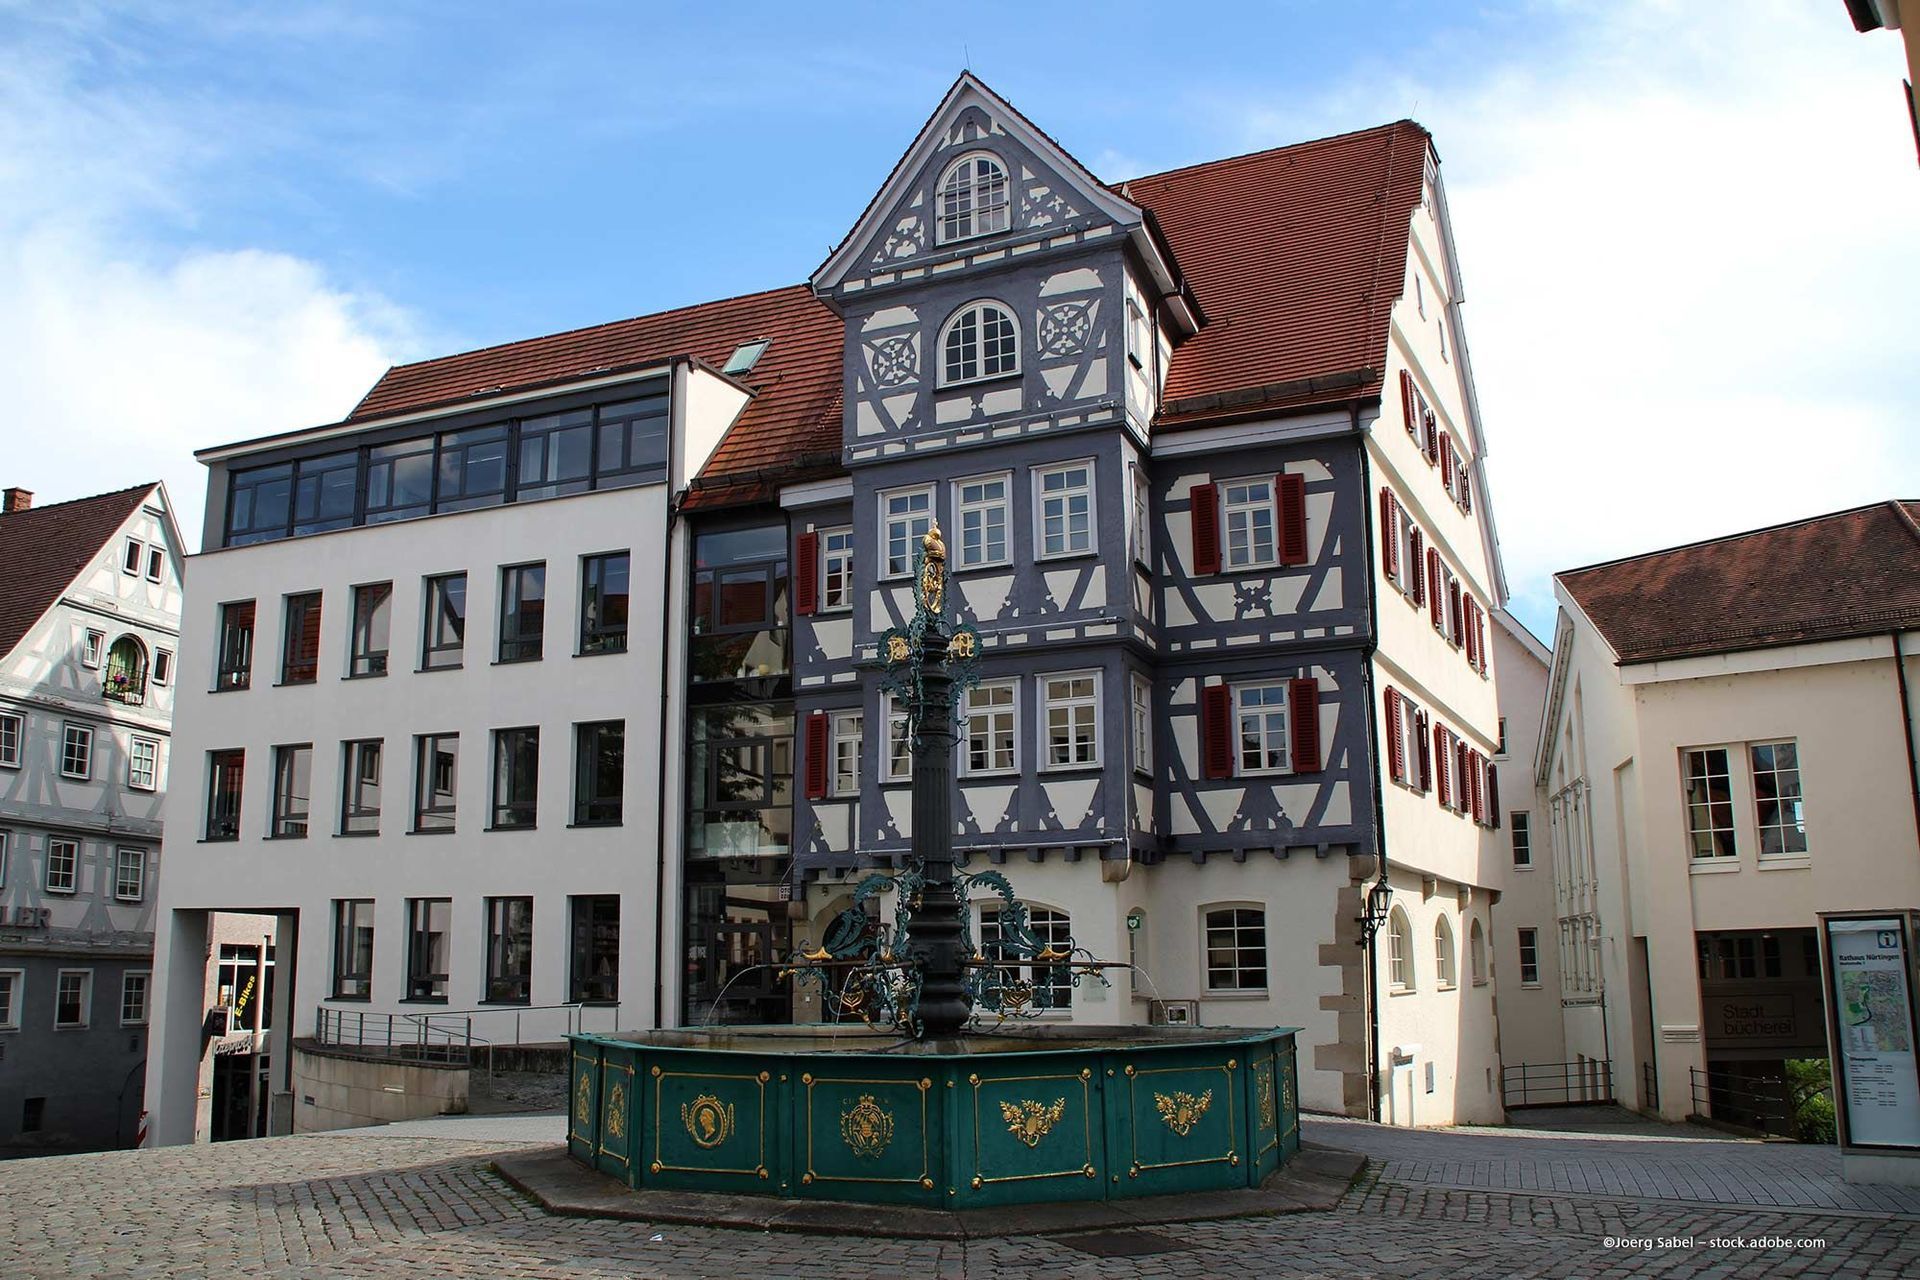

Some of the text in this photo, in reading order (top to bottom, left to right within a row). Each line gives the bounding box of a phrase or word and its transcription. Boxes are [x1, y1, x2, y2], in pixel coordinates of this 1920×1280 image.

[1866, 953, 1900, 961] Nürtingen
[235, 975, 256, 1017] E-Bikes
[1723, 1003, 1765, 1019] Stadt
[1724, 1018, 1793, 1034] bücherei
